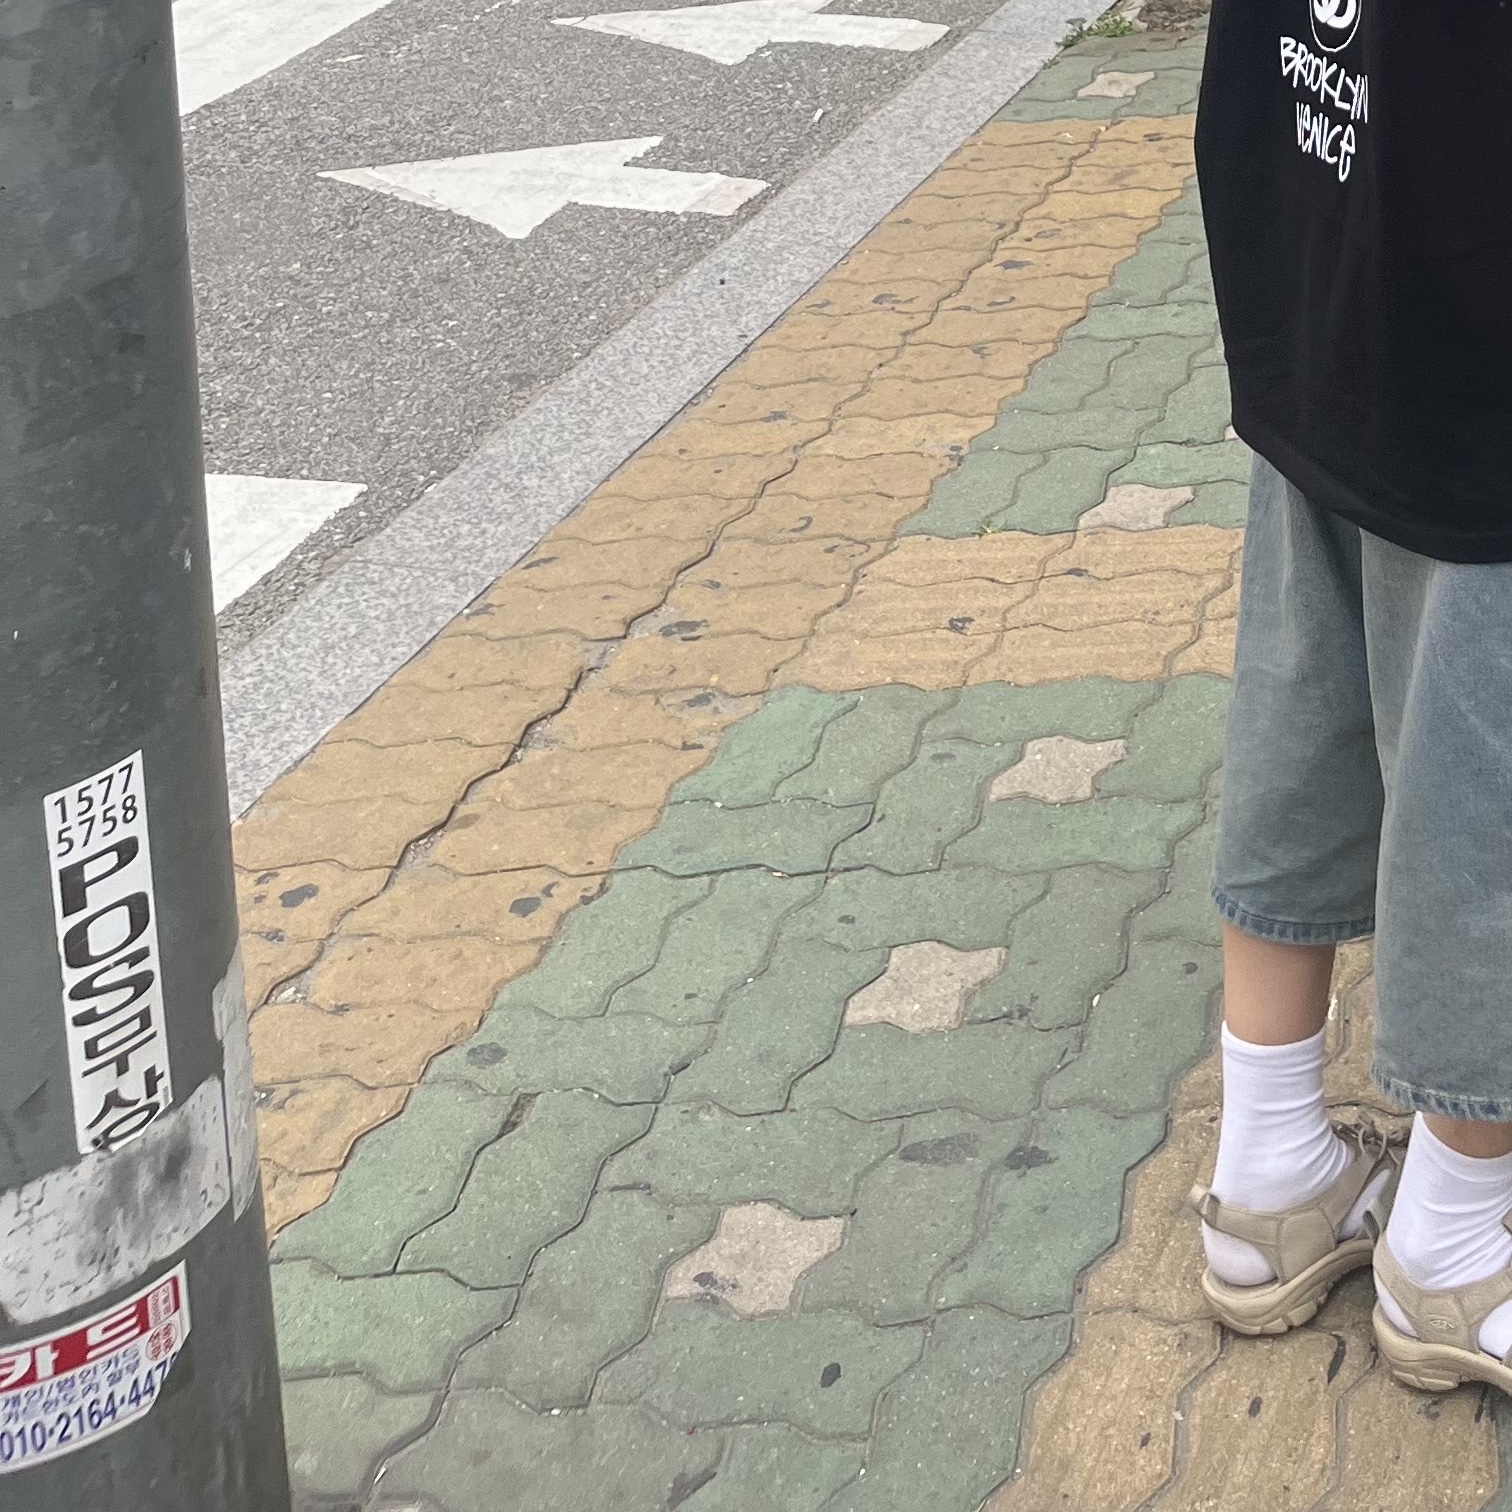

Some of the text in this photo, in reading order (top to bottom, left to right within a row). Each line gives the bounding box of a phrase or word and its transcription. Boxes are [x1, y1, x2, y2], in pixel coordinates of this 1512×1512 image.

[1279, 35, 1369, 124] BROOKLYN
[53, 761, 134, 825] 1577
[56, 793, 138, 857] 5758
